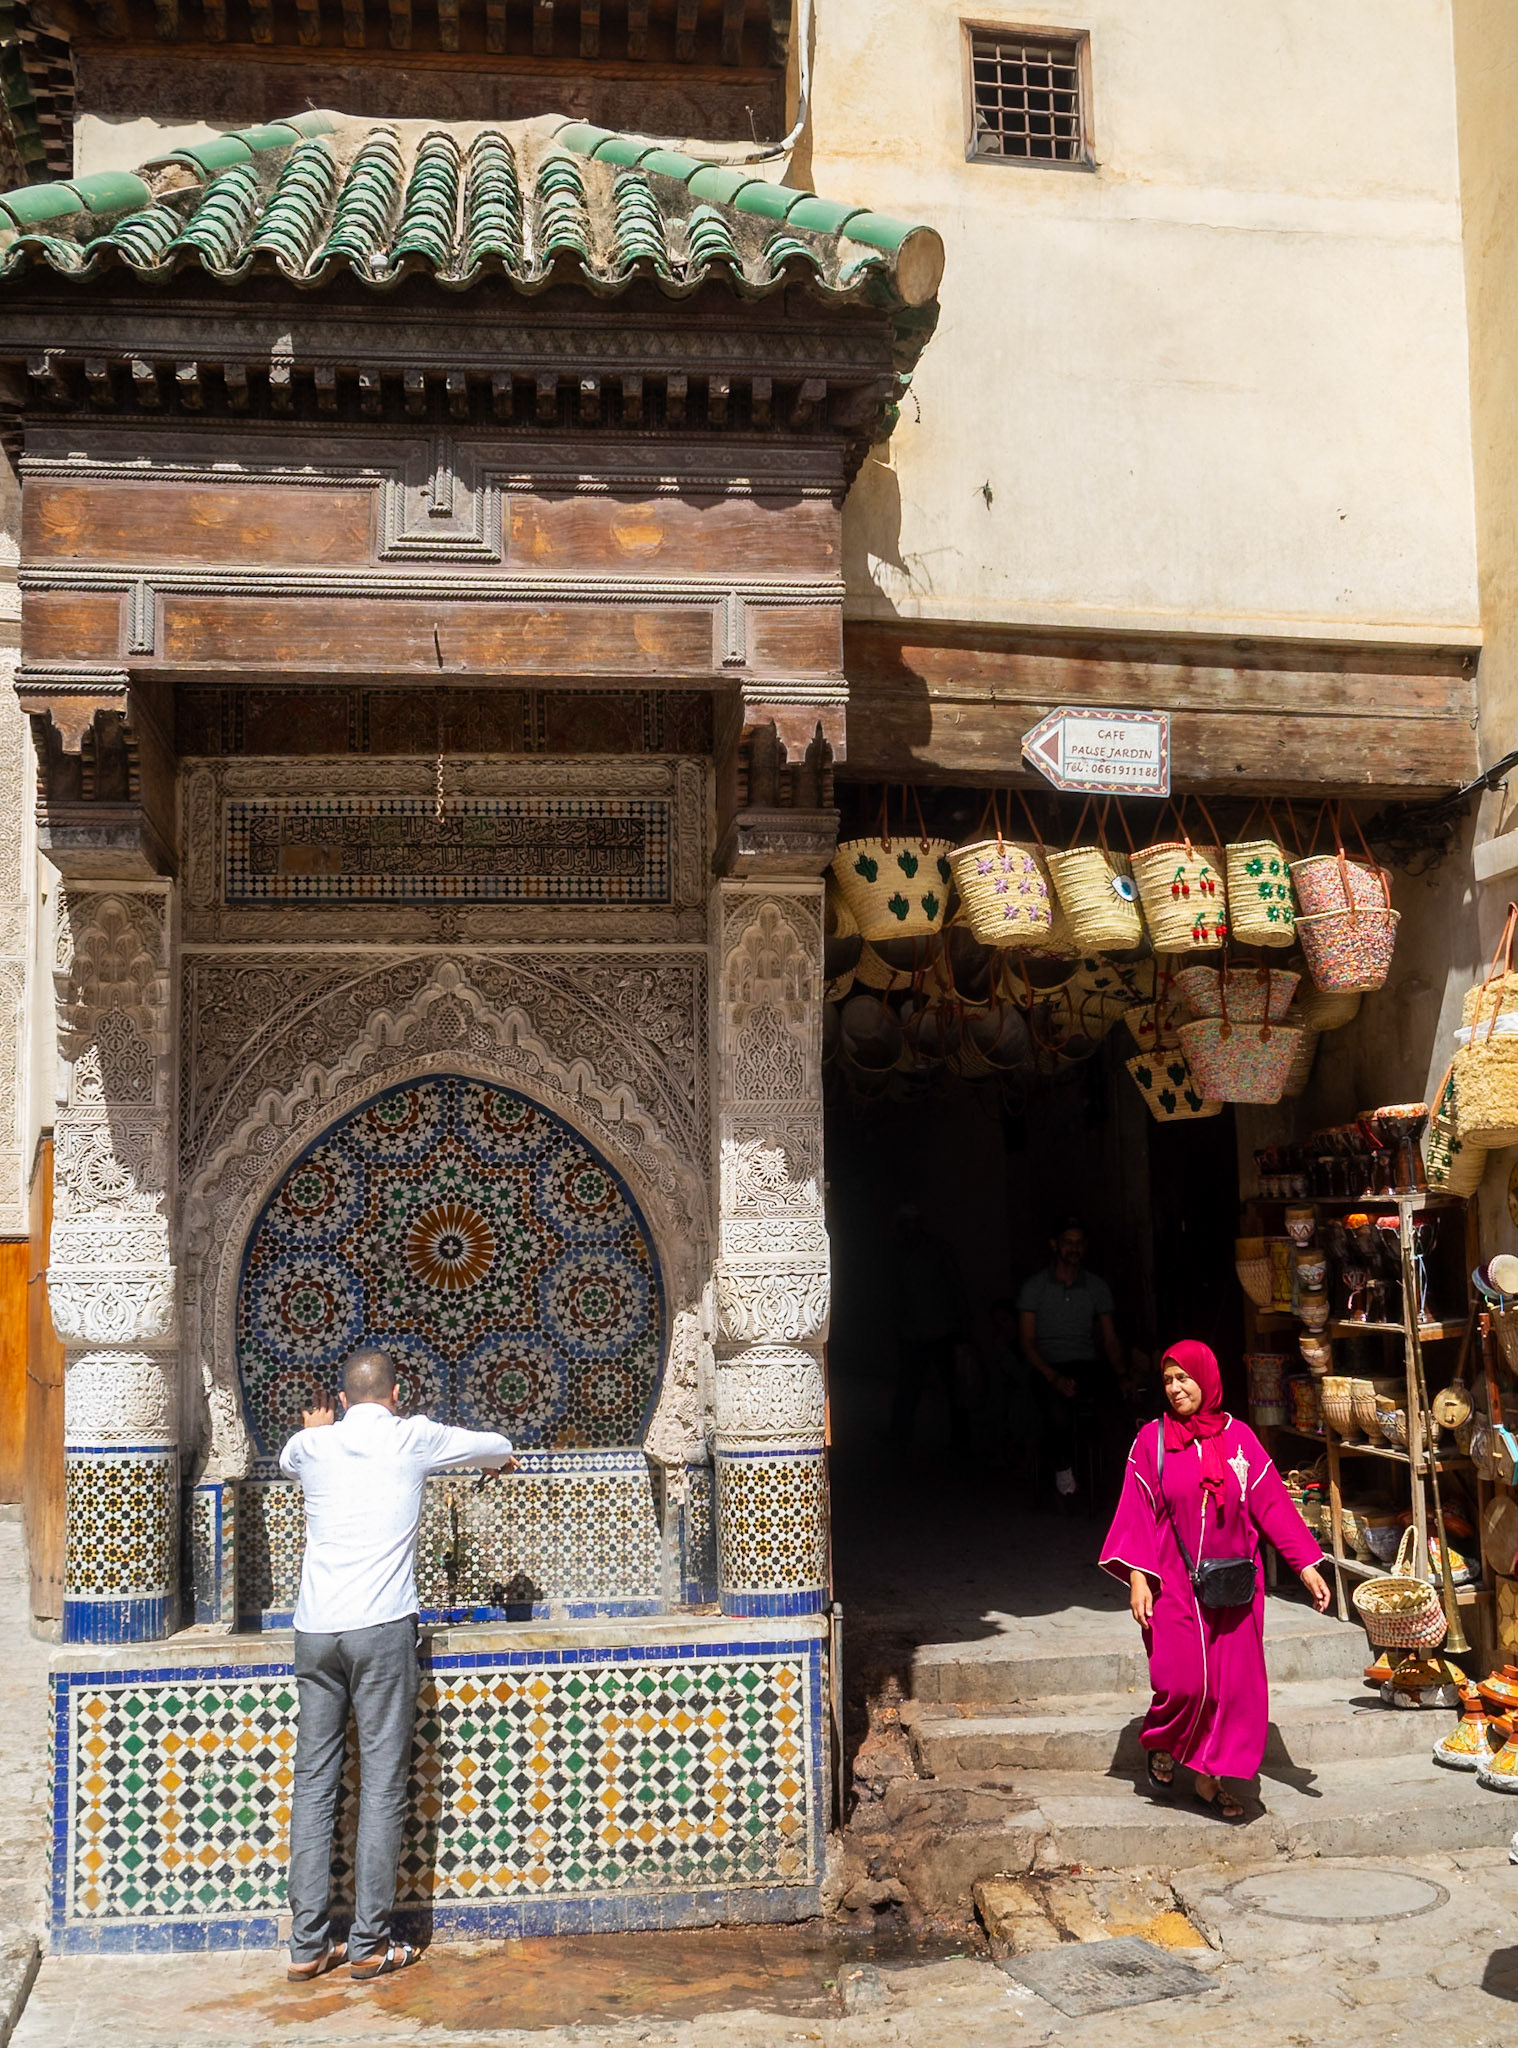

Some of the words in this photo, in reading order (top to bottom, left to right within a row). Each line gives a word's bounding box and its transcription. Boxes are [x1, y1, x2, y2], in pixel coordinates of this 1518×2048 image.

[1097, 730, 1125, 741] CAFE
[1071, 745, 1106, 757] PAUSE
[1107, 748, 1152, 759] JARDIN
[1091, 764, 1157, 777] 0661911188
